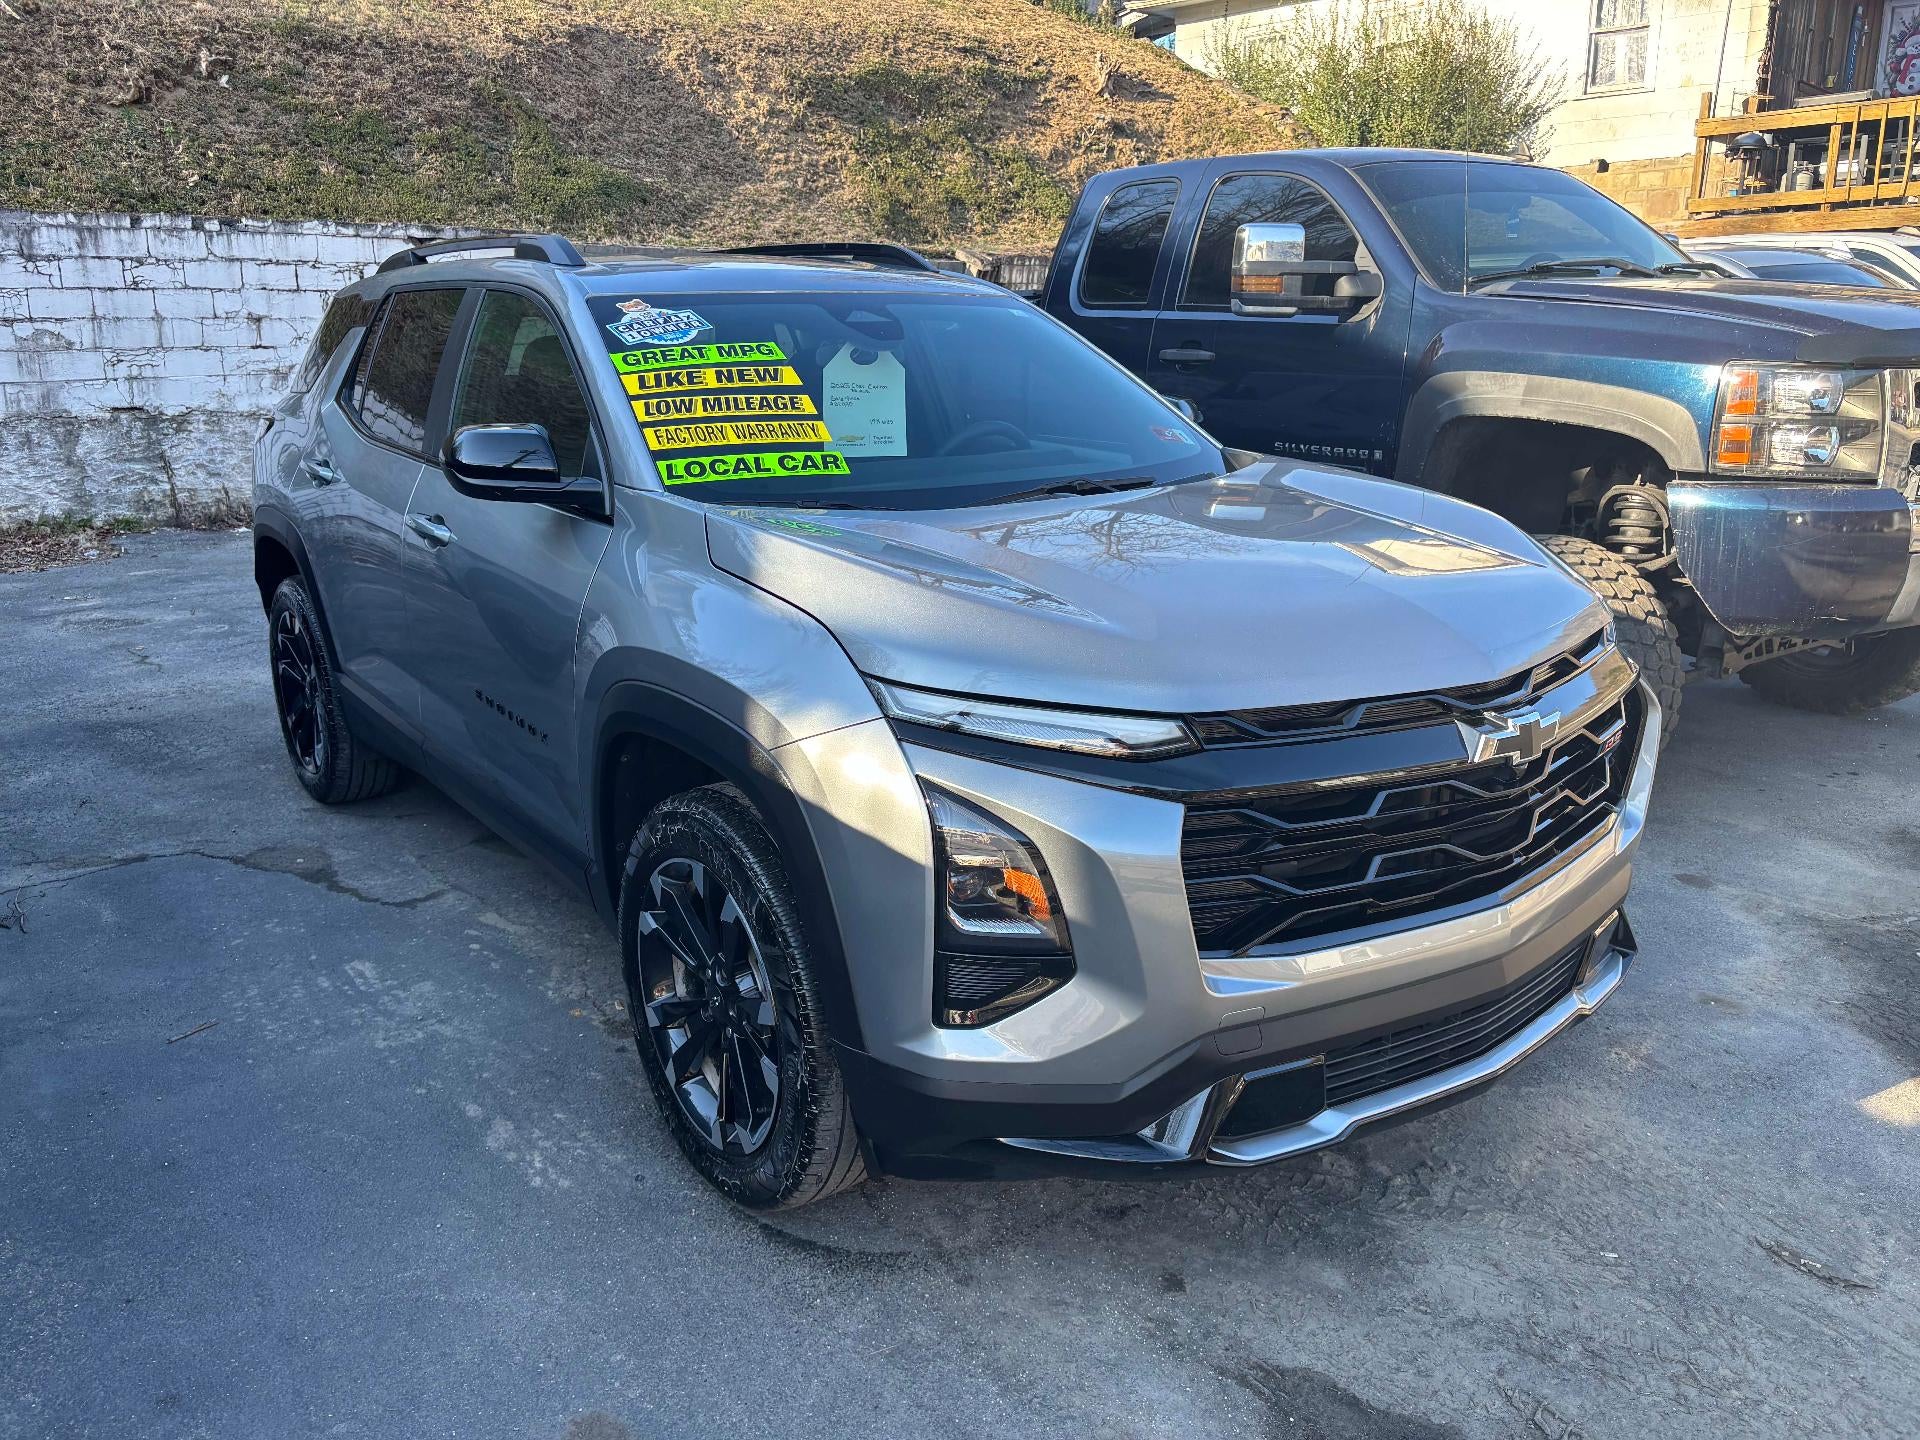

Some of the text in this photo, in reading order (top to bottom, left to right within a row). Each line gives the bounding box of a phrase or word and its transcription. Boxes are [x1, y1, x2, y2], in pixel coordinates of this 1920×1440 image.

[616, 313, 695, 333] CARFAX
[640, 320, 702, 338] OWNER
[622, 343, 776, 367] GREAT MPG
[638, 367, 781, 389] LIKE NEW
[644, 395, 803, 417] LOW MILEAGE
[653, 422, 820, 446] FACTORY WARRANTY
[1274, 441, 1369, 459] SILVERADO
[666, 453, 842, 480] LOCAL CAR
